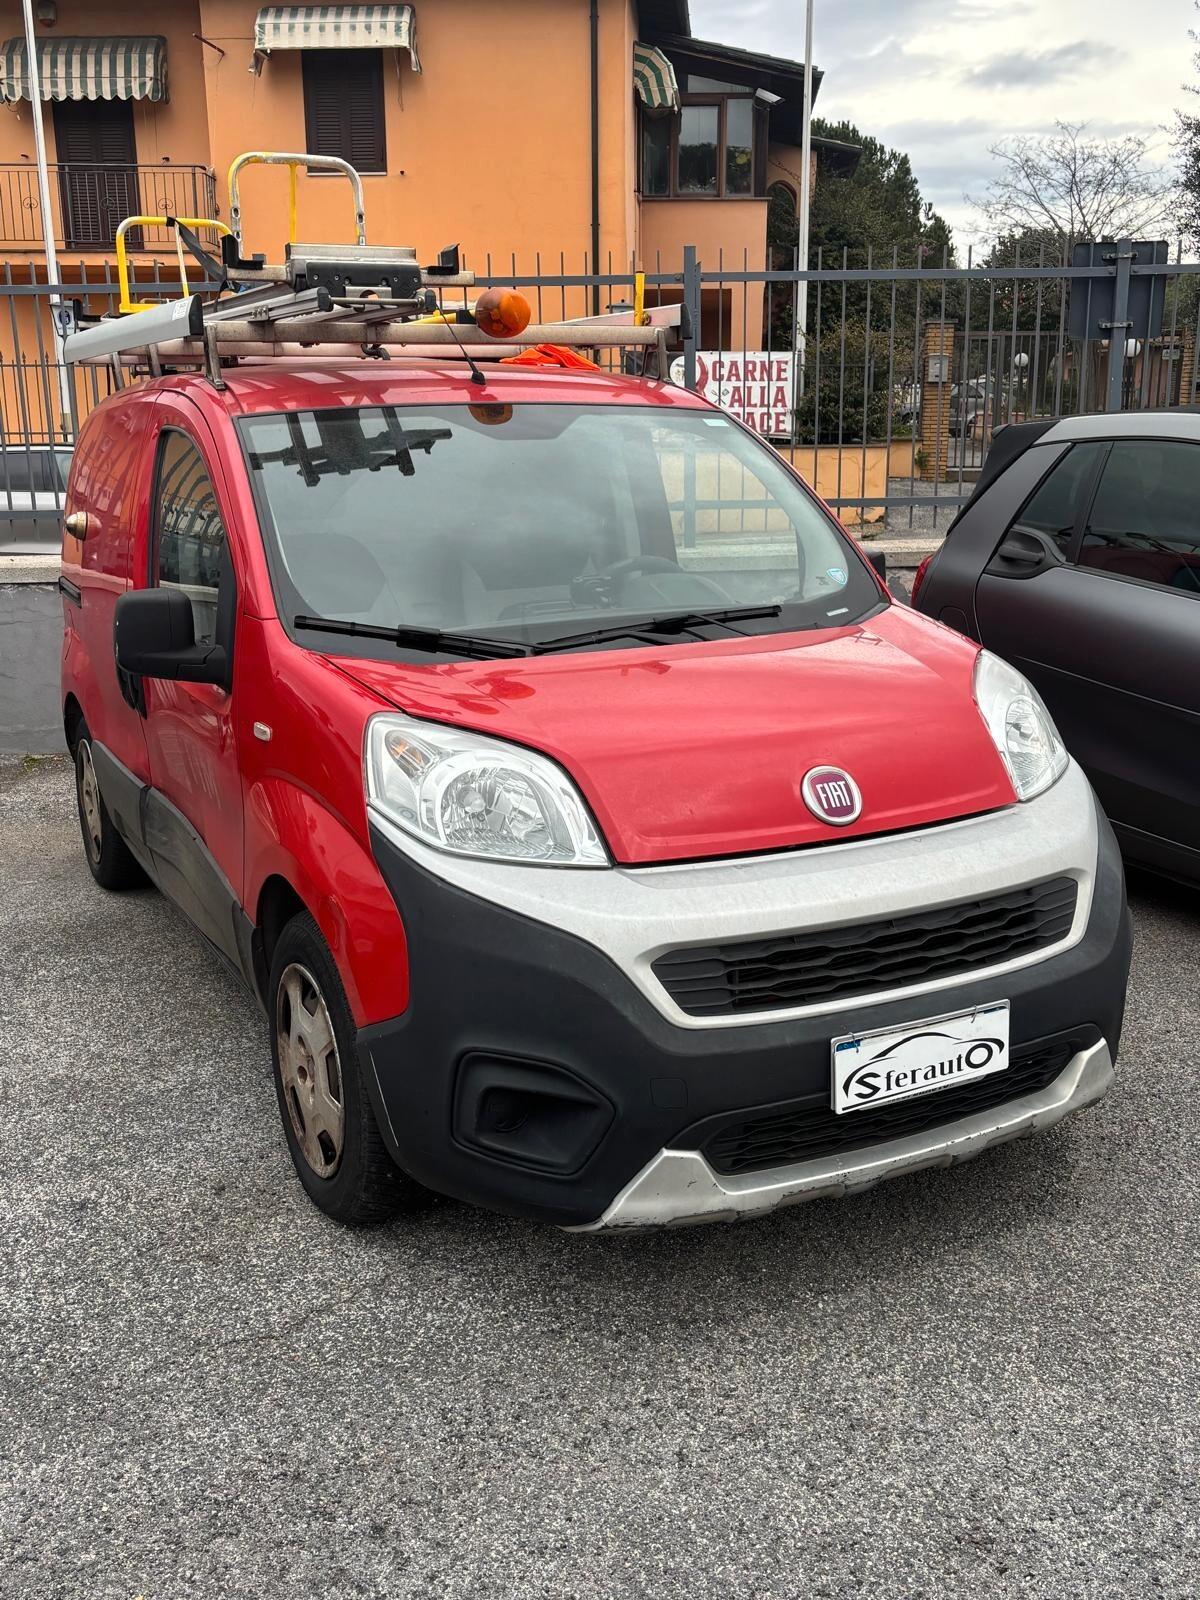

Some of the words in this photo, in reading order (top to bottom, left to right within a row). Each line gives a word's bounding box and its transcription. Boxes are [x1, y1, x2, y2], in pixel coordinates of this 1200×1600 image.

[711, 360, 789, 382] CARNE
[728, 386, 788, 408] ALLA
[730, 412, 788, 433] ACE
[816, 781, 851, 810] FIAT
